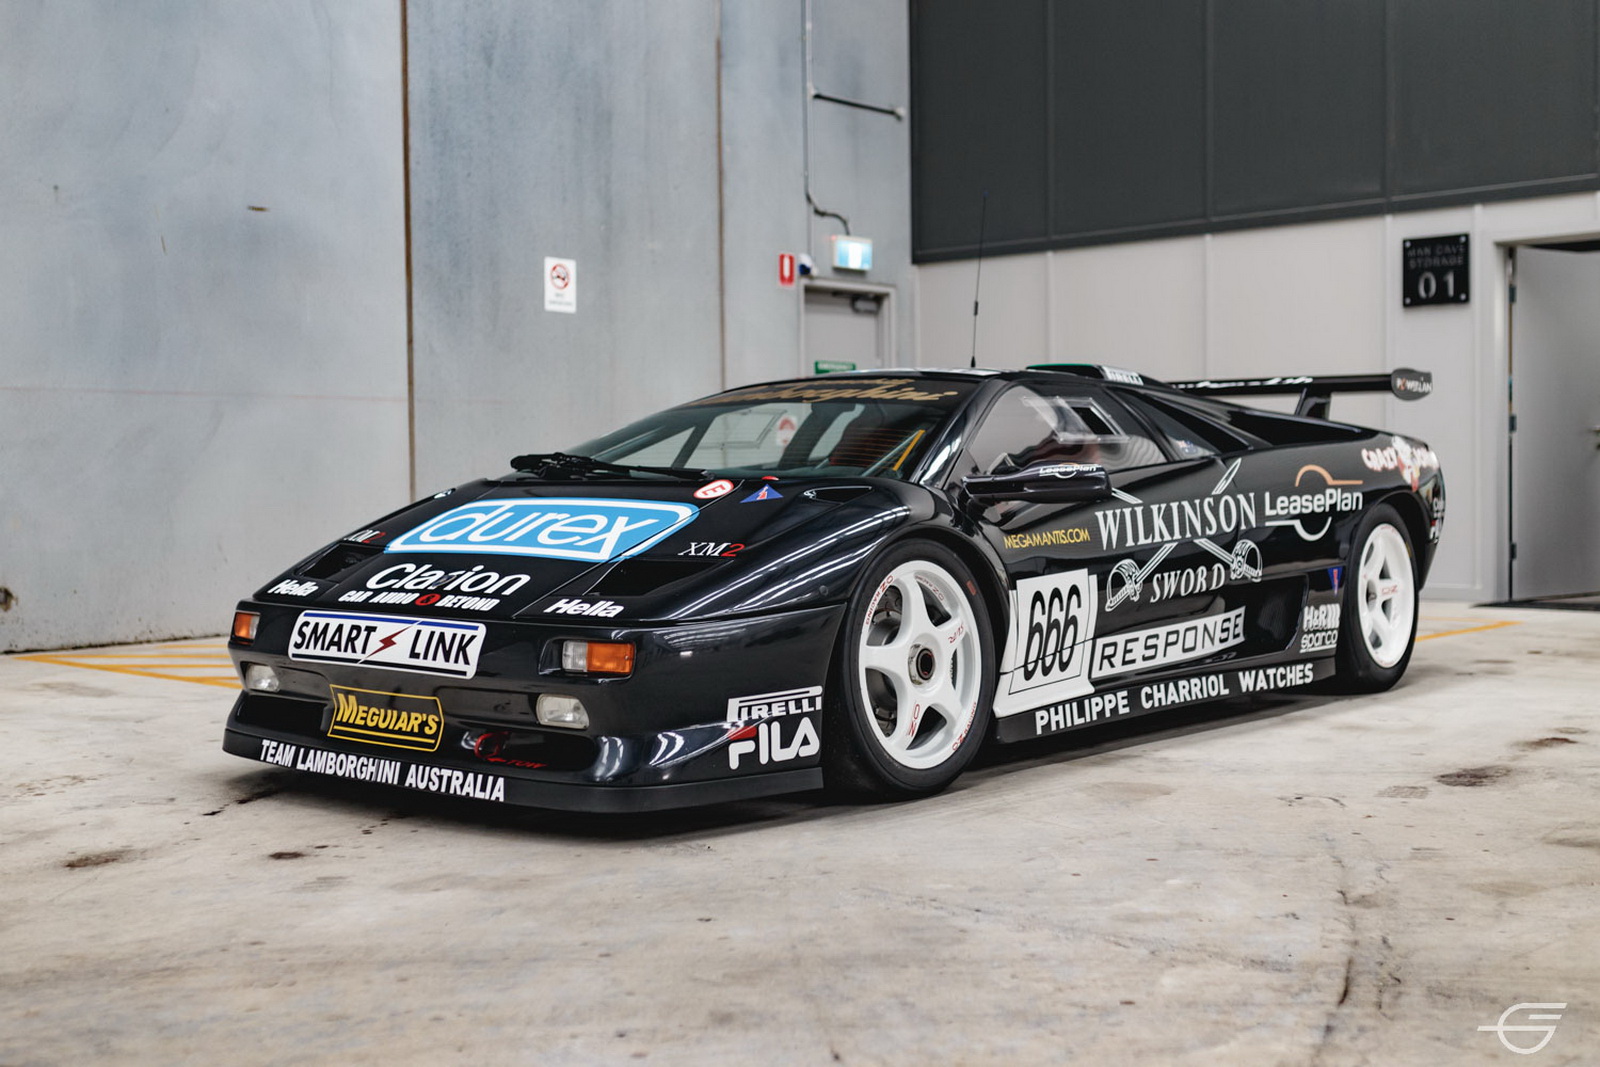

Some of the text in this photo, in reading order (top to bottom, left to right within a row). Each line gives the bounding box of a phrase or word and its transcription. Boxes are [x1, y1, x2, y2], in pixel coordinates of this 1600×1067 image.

[1418, 270, 1455, 300] 01
[1095, 492, 1258, 550] WILKINSON
[1264, 488, 1363, 516] LeasePlan
[418, 501, 659, 560] durex
[678, 541, 745, 557] XM2
[1003, 528, 1090, 549] MEGAMANTIS.COM
[266, 579, 320, 597] Hella
[366, 563, 531, 596] Clarion
[1150, 563, 1226, 603] SWORD
[337, 590, 374, 603] CAR
[368, 591, 421, 605] AUDIO
[434, 595, 500, 611] BEYOND
[544, 598, 624, 618] Hella
[293, 620, 478, 665] SMART LINK
[1024, 584, 1082, 681] 666
[1098, 611, 1243, 672] RESPONSE
[1300, 630, 1338, 651] sparco
[335, 693, 440, 736] MEGUIAR'S
[726, 685, 823, 722] PIRELLI
[1035, 662, 1315, 735] PHILIPPE CHARRIOL WATCHES
[728, 716, 821, 770] FILA
[259, 739, 505, 801] TEAM LAMBORGHINI AUSTRALIA
